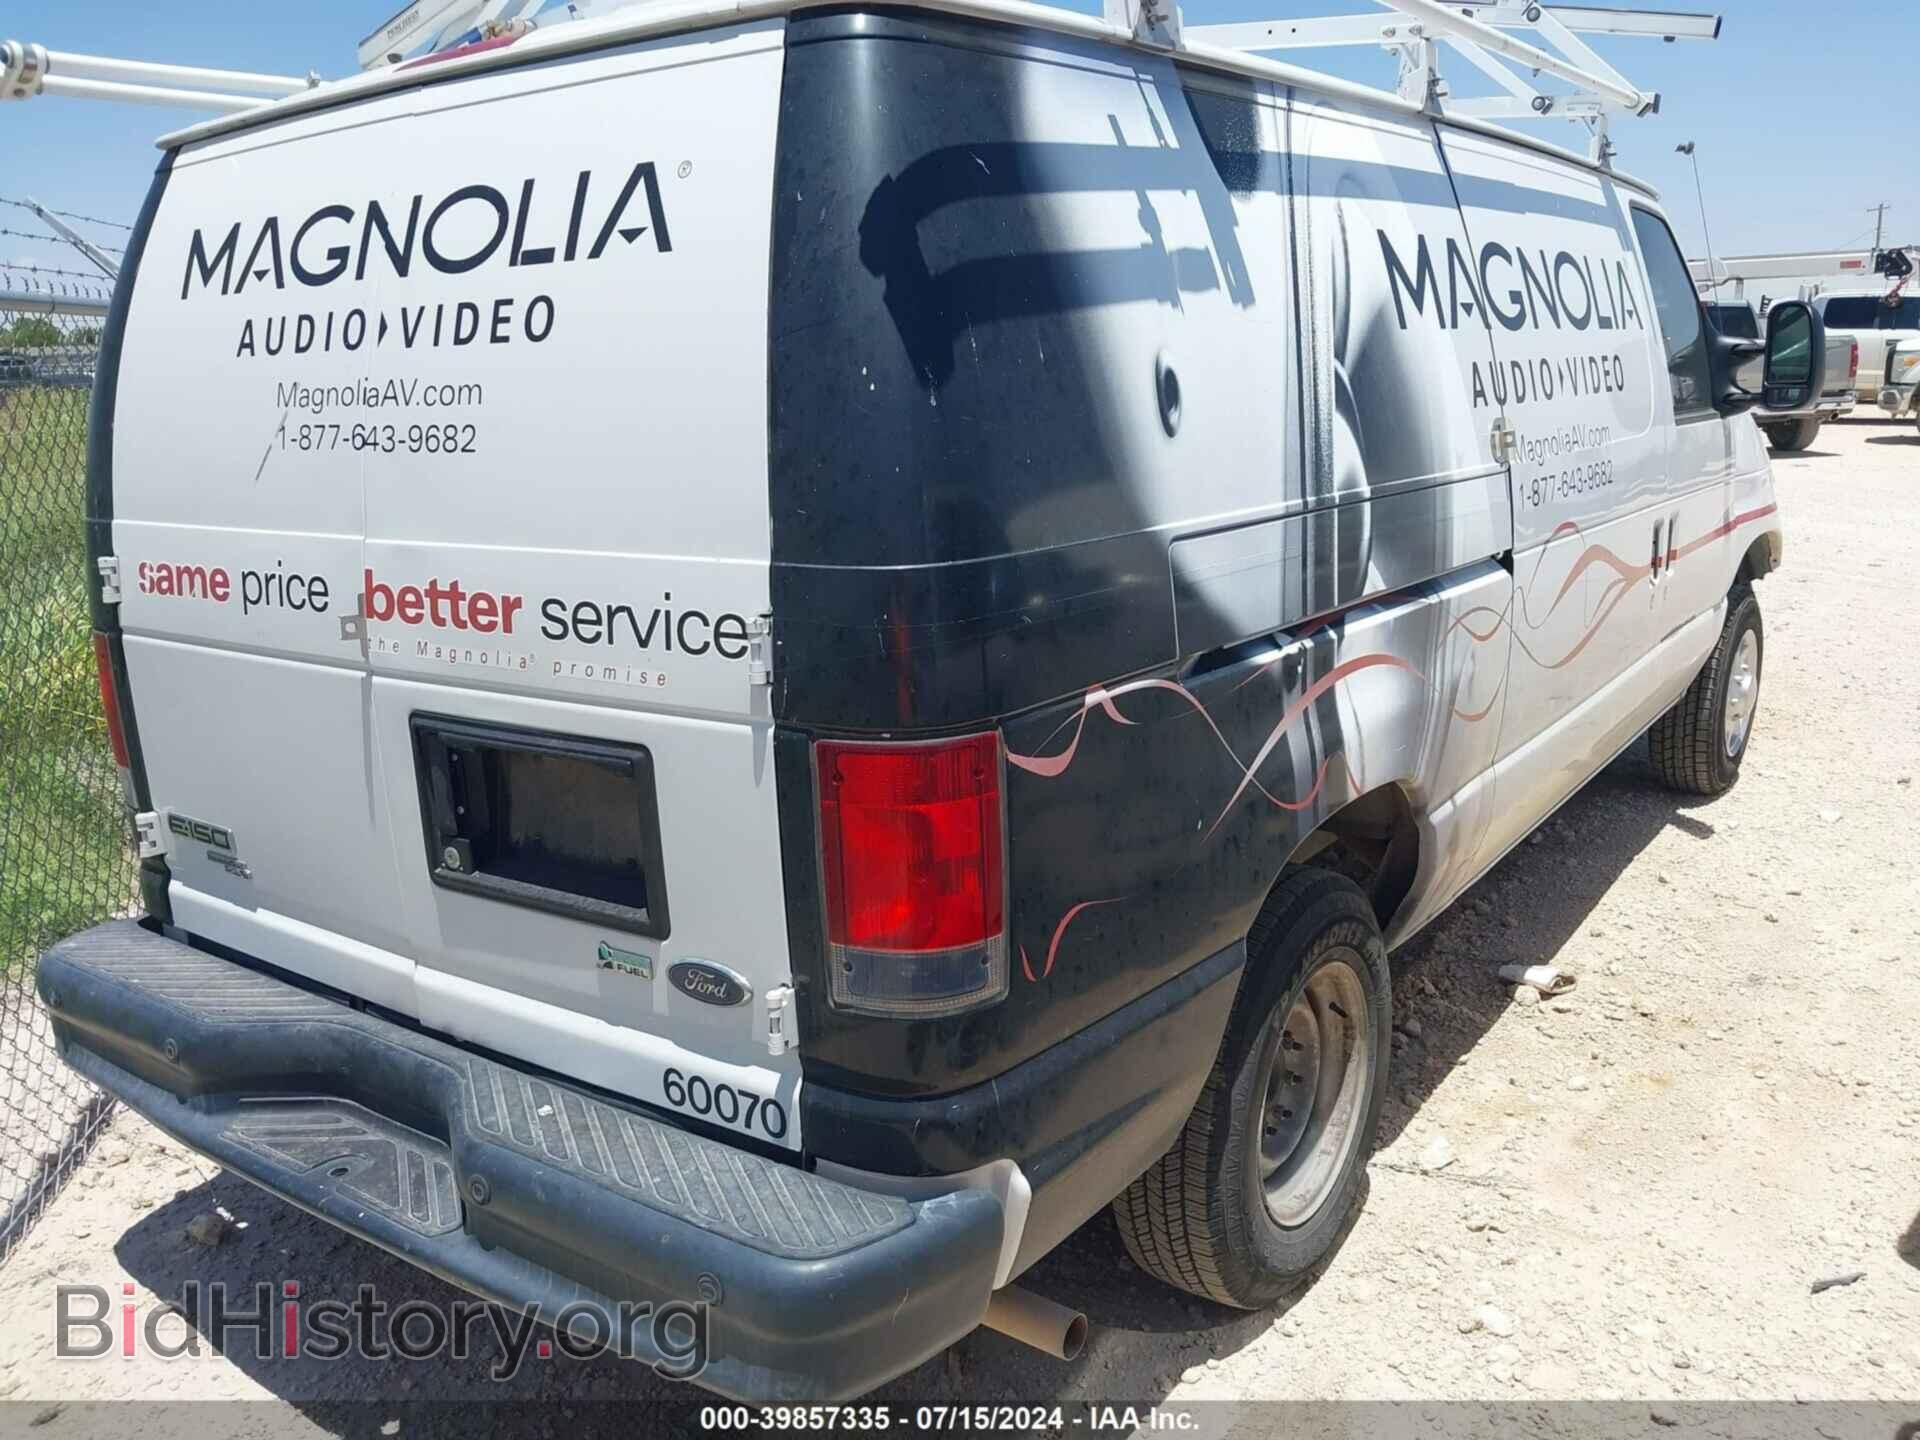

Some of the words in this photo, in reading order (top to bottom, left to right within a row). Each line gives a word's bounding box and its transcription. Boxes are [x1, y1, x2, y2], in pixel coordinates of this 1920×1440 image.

[181, 160, 673, 300] MAGNOLIA
[1376, 228, 1644, 332] MAGNOLIA
[236, 307, 367, 358] AUDIO
[400, 294, 555, 349] VIDEO
[276, 376, 482, 415] MagnoliaAV.com
[1471, 357, 1556, 409] AUDIO
[1566, 353, 1625, 397] VIDEO
[279, 422, 477, 454] 1-877-643-9682
[138, 561, 231, 603] same
[241, 559, 330, 614] price
[364, 568, 523, 635] better
[540, 591, 750, 660] service
[552, 659, 667, 687] promise
[616, 961, 650, 979] FUEL
[684, 967, 729, 1000] Ford
[663, 1067, 788, 1139] 60070
